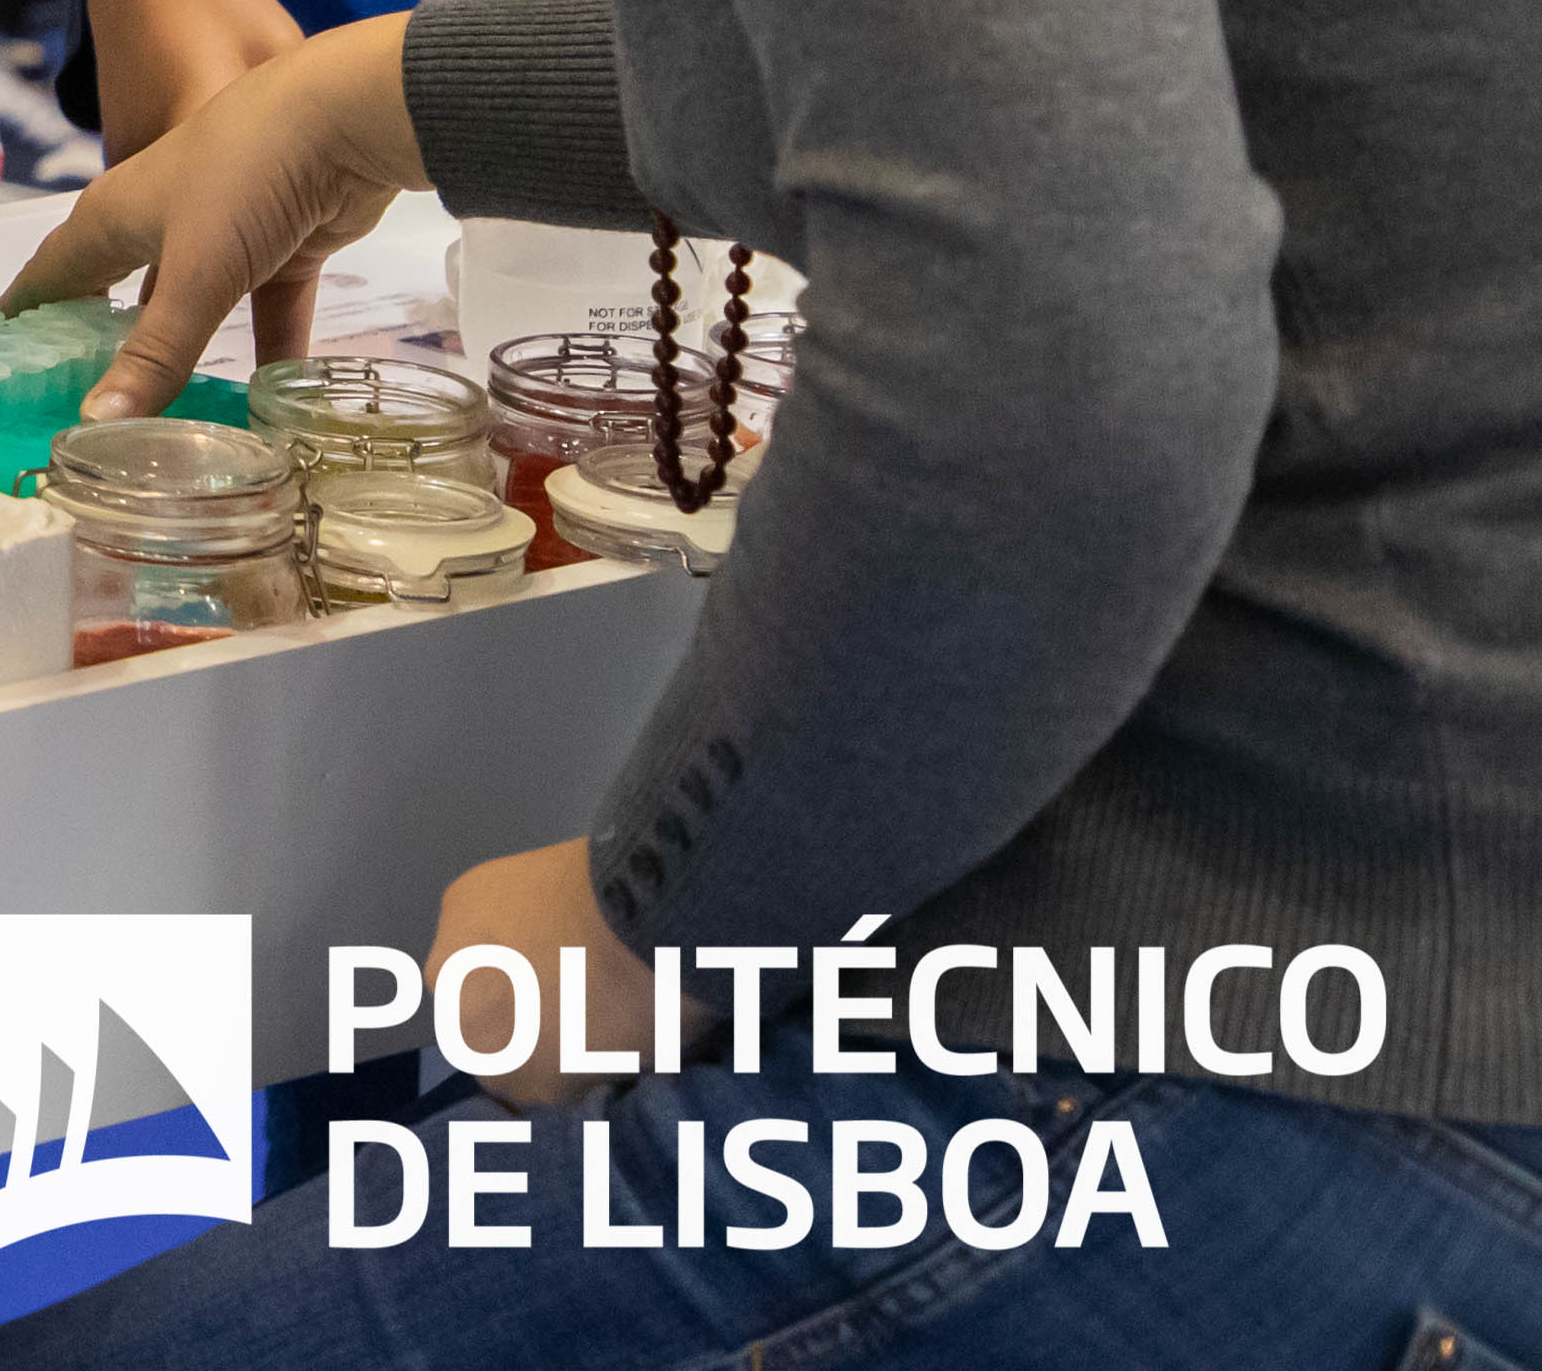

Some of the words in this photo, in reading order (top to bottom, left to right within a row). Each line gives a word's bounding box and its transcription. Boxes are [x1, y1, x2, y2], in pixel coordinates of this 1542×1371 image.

[588, 307, 615, 319] NOT
[619, 307, 644, 318] FOR
[588, 321, 615, 331] FOR
[619, 320, 652, 332] DISPE
